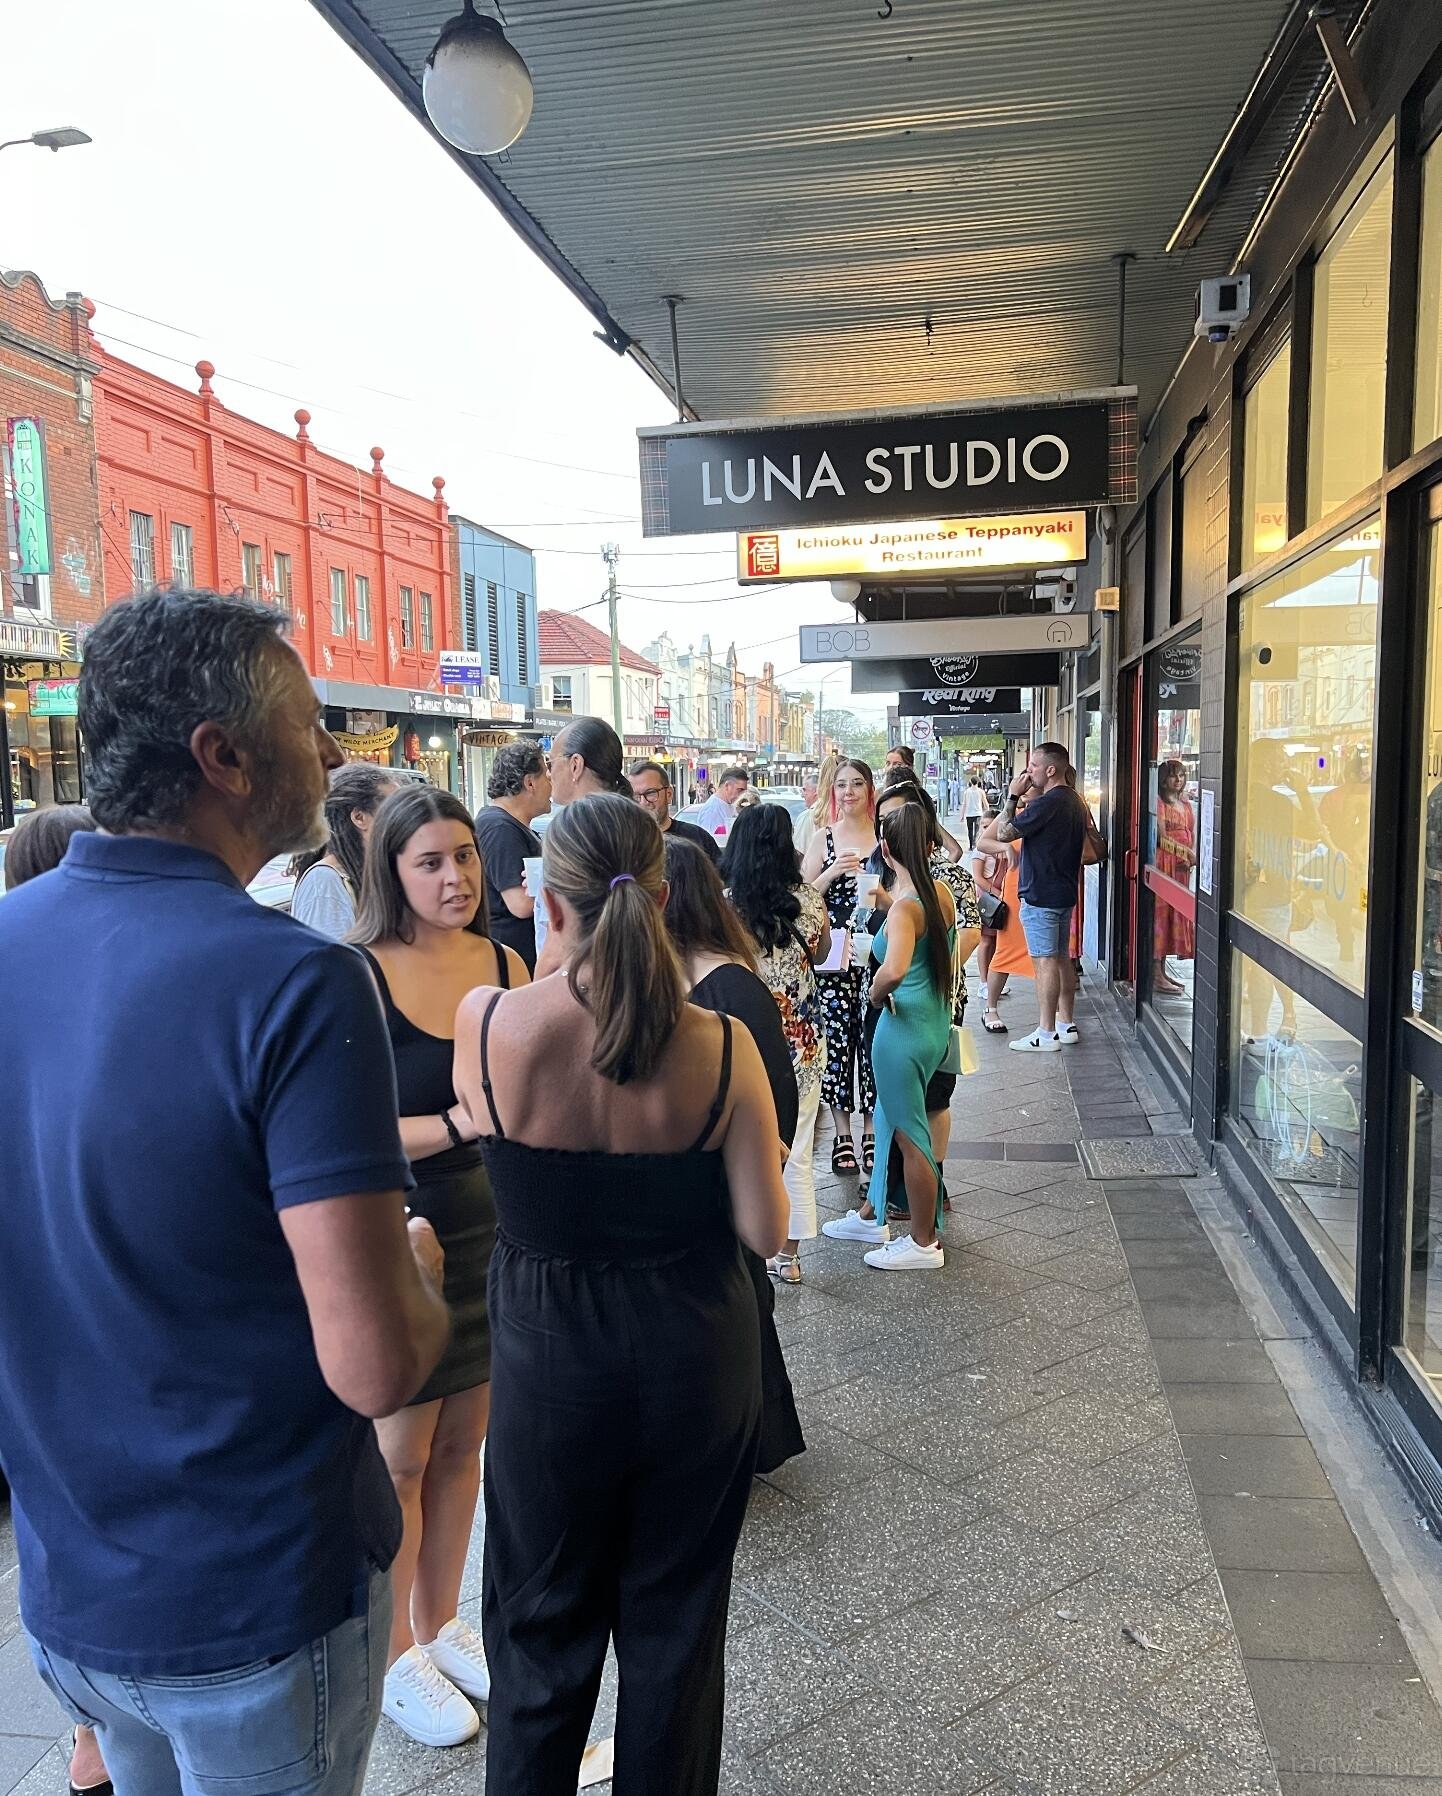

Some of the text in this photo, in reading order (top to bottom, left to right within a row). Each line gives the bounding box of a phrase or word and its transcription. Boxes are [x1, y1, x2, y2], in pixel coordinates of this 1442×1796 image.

[702, 434, 1070, 506] LUNA STUDIO
[19, 458, 39, 566] KONAK
[797, 520, 1073, 549] Ichioku Japanese Teppanyaki
[882, 547, 982, 562] Restaurant
[816, 629, 871, 653] BOB
[455, 656, 480, 664] LEASE
[469, 734, 509, 745] VINTAGE
